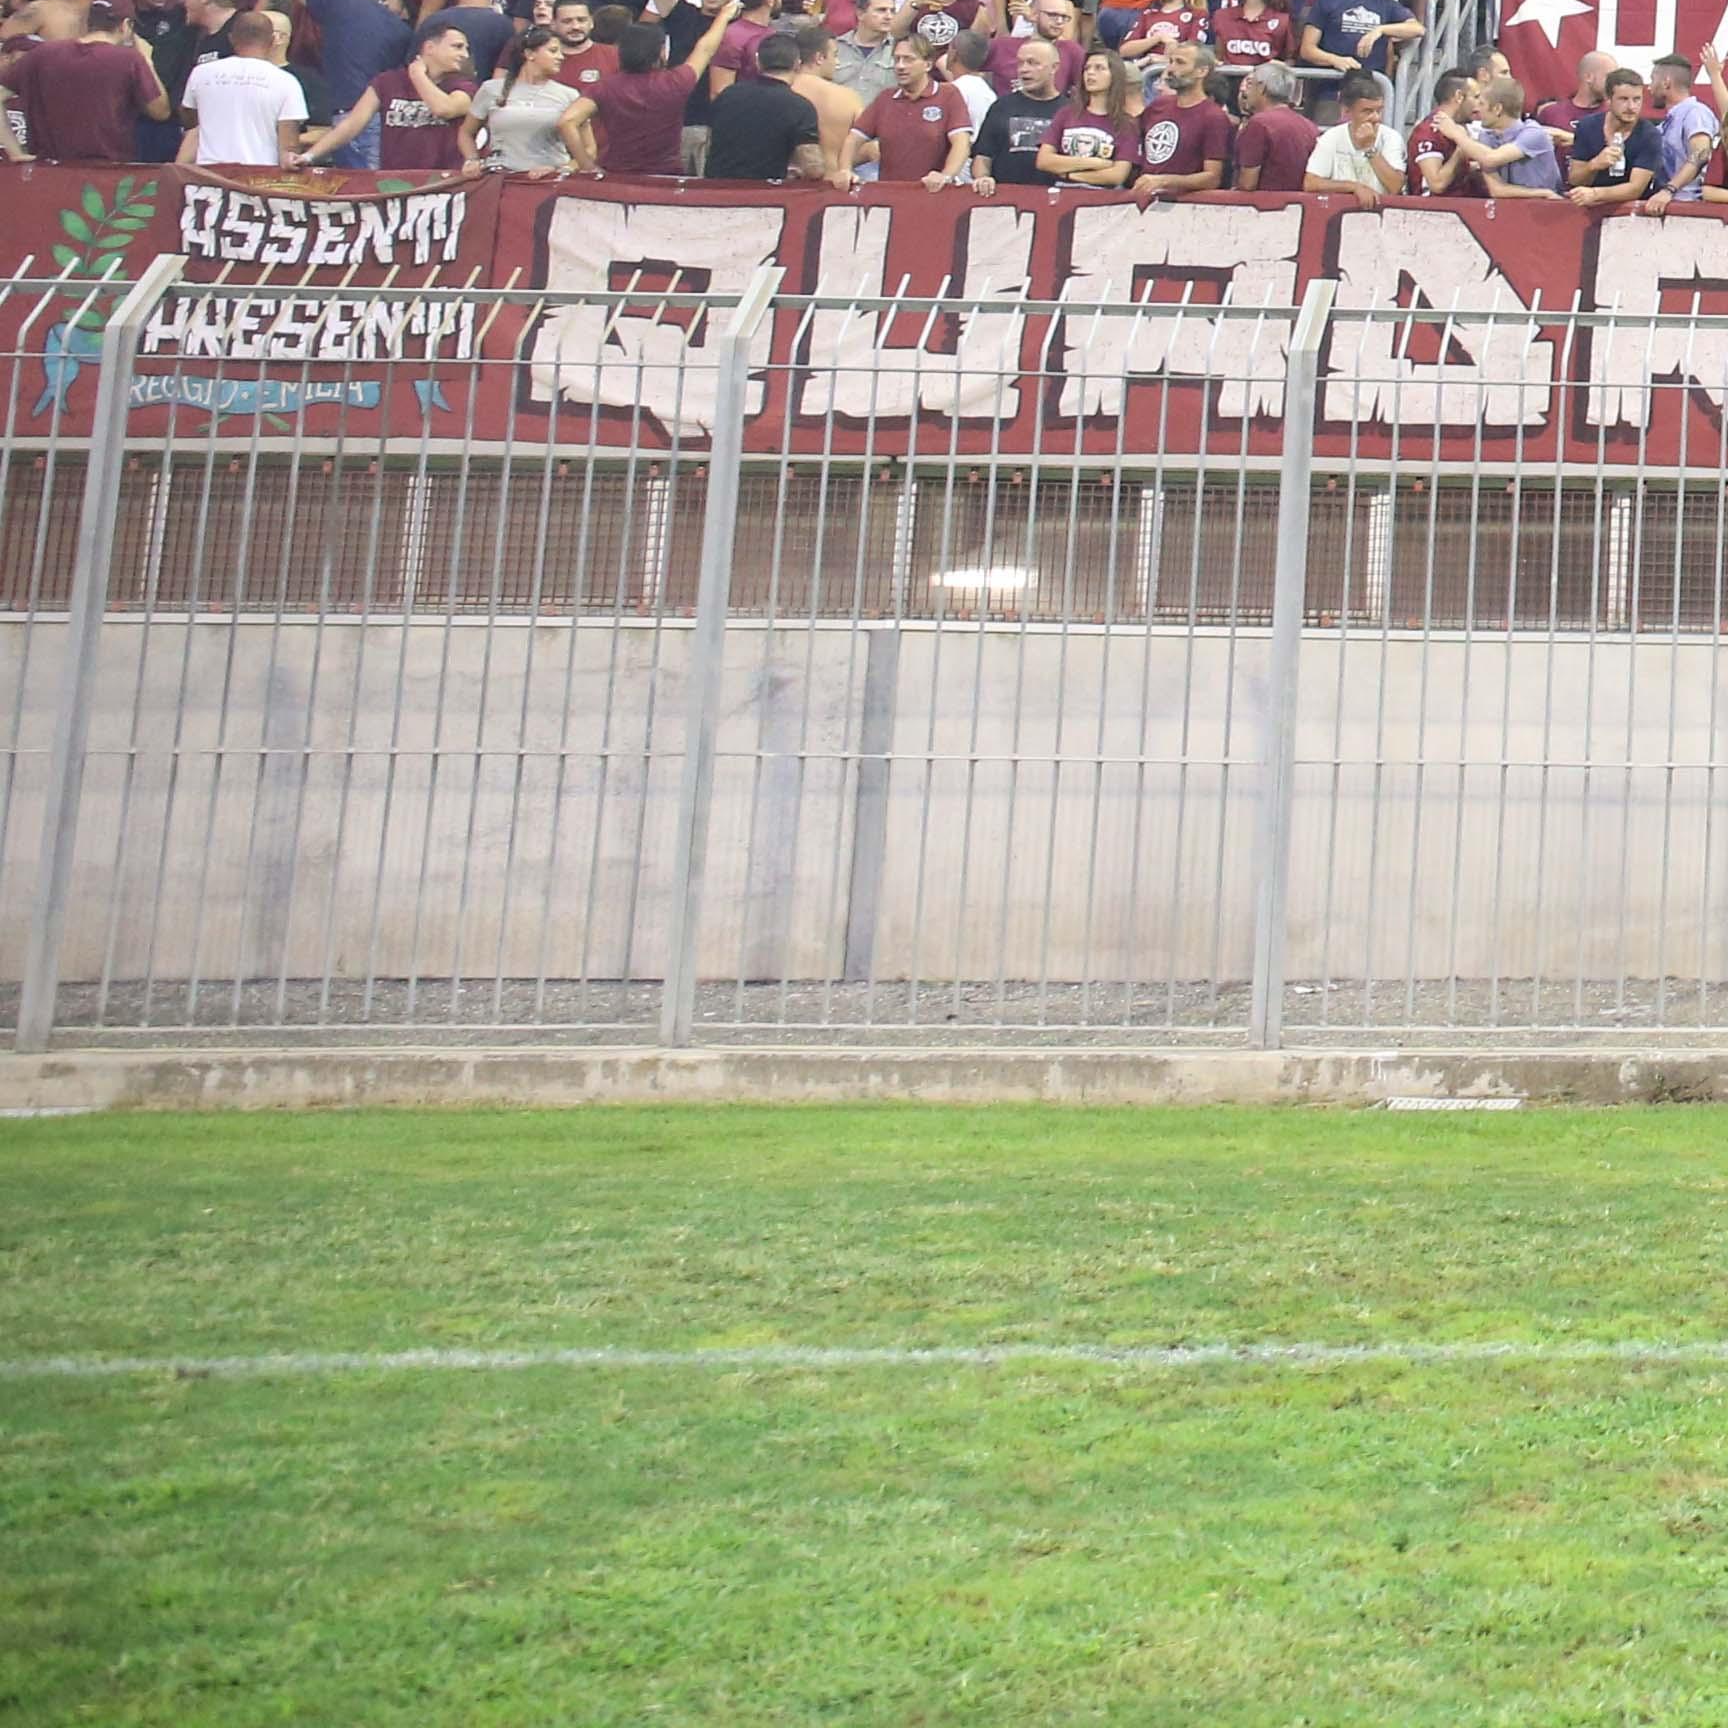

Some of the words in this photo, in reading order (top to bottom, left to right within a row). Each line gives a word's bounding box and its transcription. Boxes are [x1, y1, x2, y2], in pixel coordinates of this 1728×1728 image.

[179, 183, 466, 266] ASSENTI
[143, 285, 475, 361] PRESENTI
[262, 379, 365, 413] EMILIA
